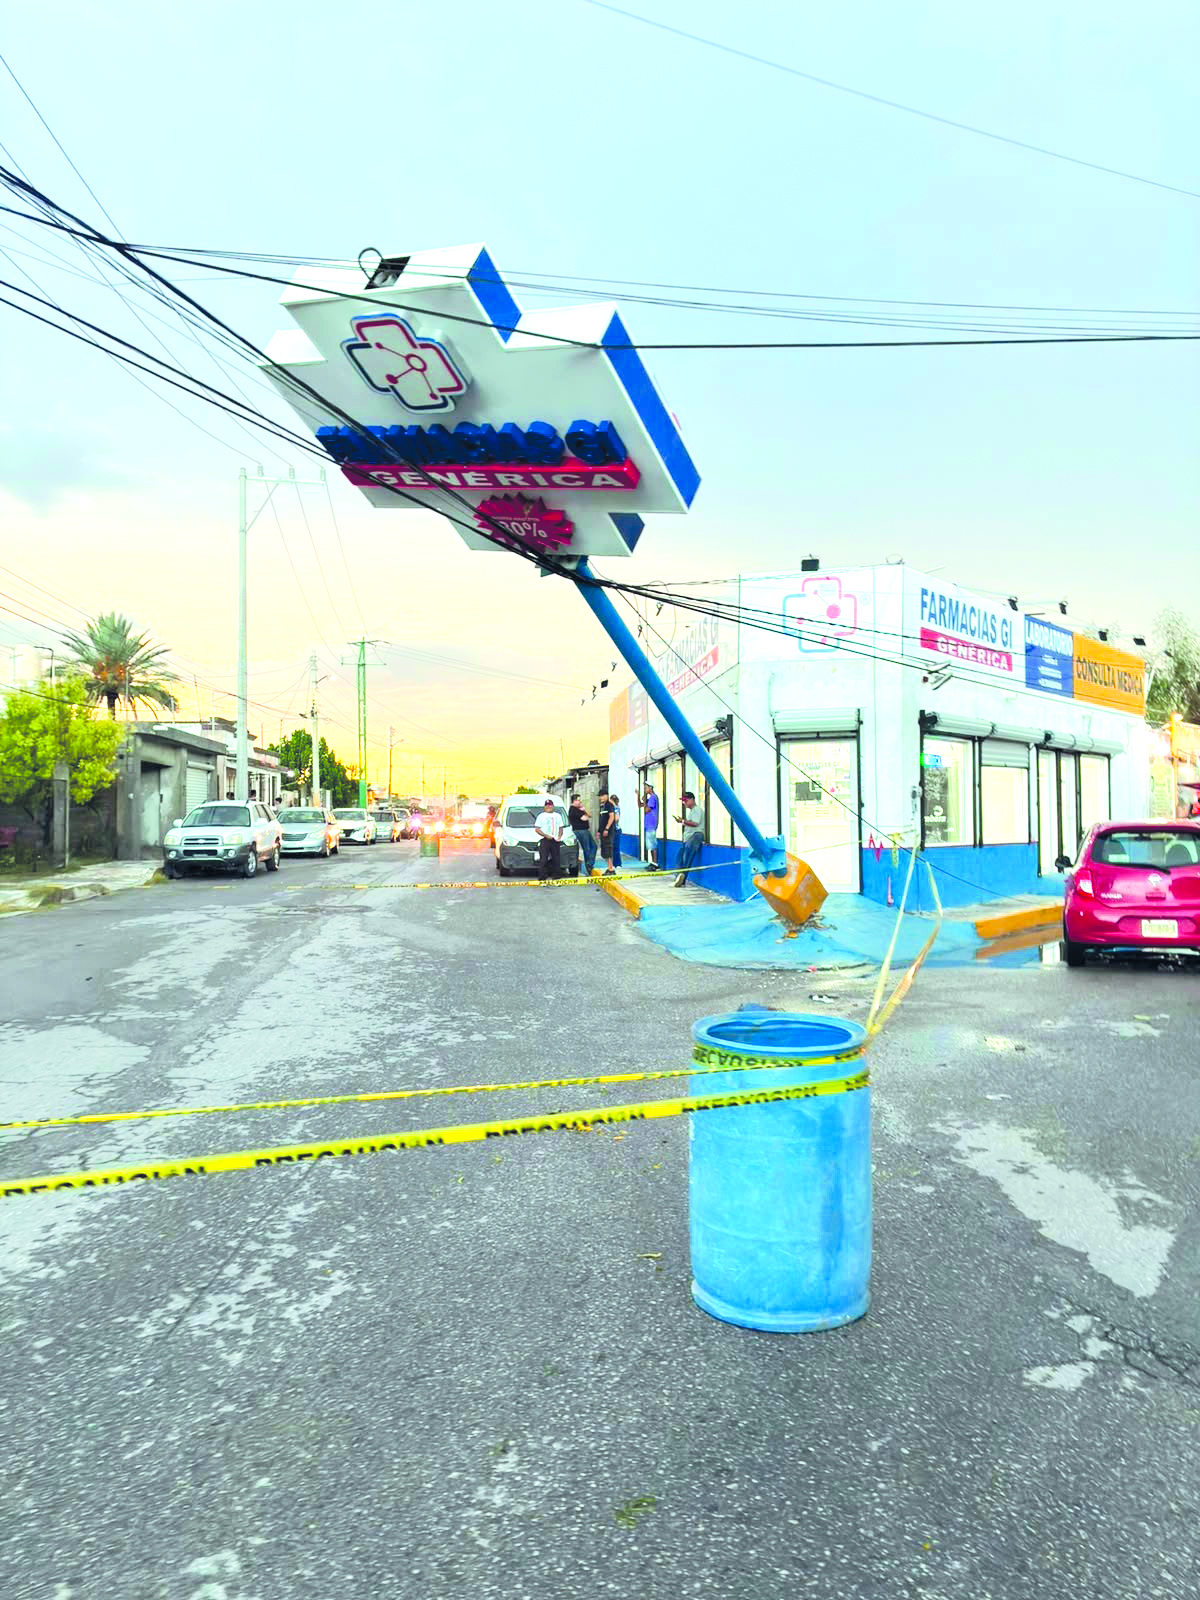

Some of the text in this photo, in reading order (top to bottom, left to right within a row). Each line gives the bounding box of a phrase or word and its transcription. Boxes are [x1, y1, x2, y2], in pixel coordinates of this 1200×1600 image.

[921, 586, 1013, 650] FARMACIAS GI
[1076, 656, 1116, 689] CONSULTA
